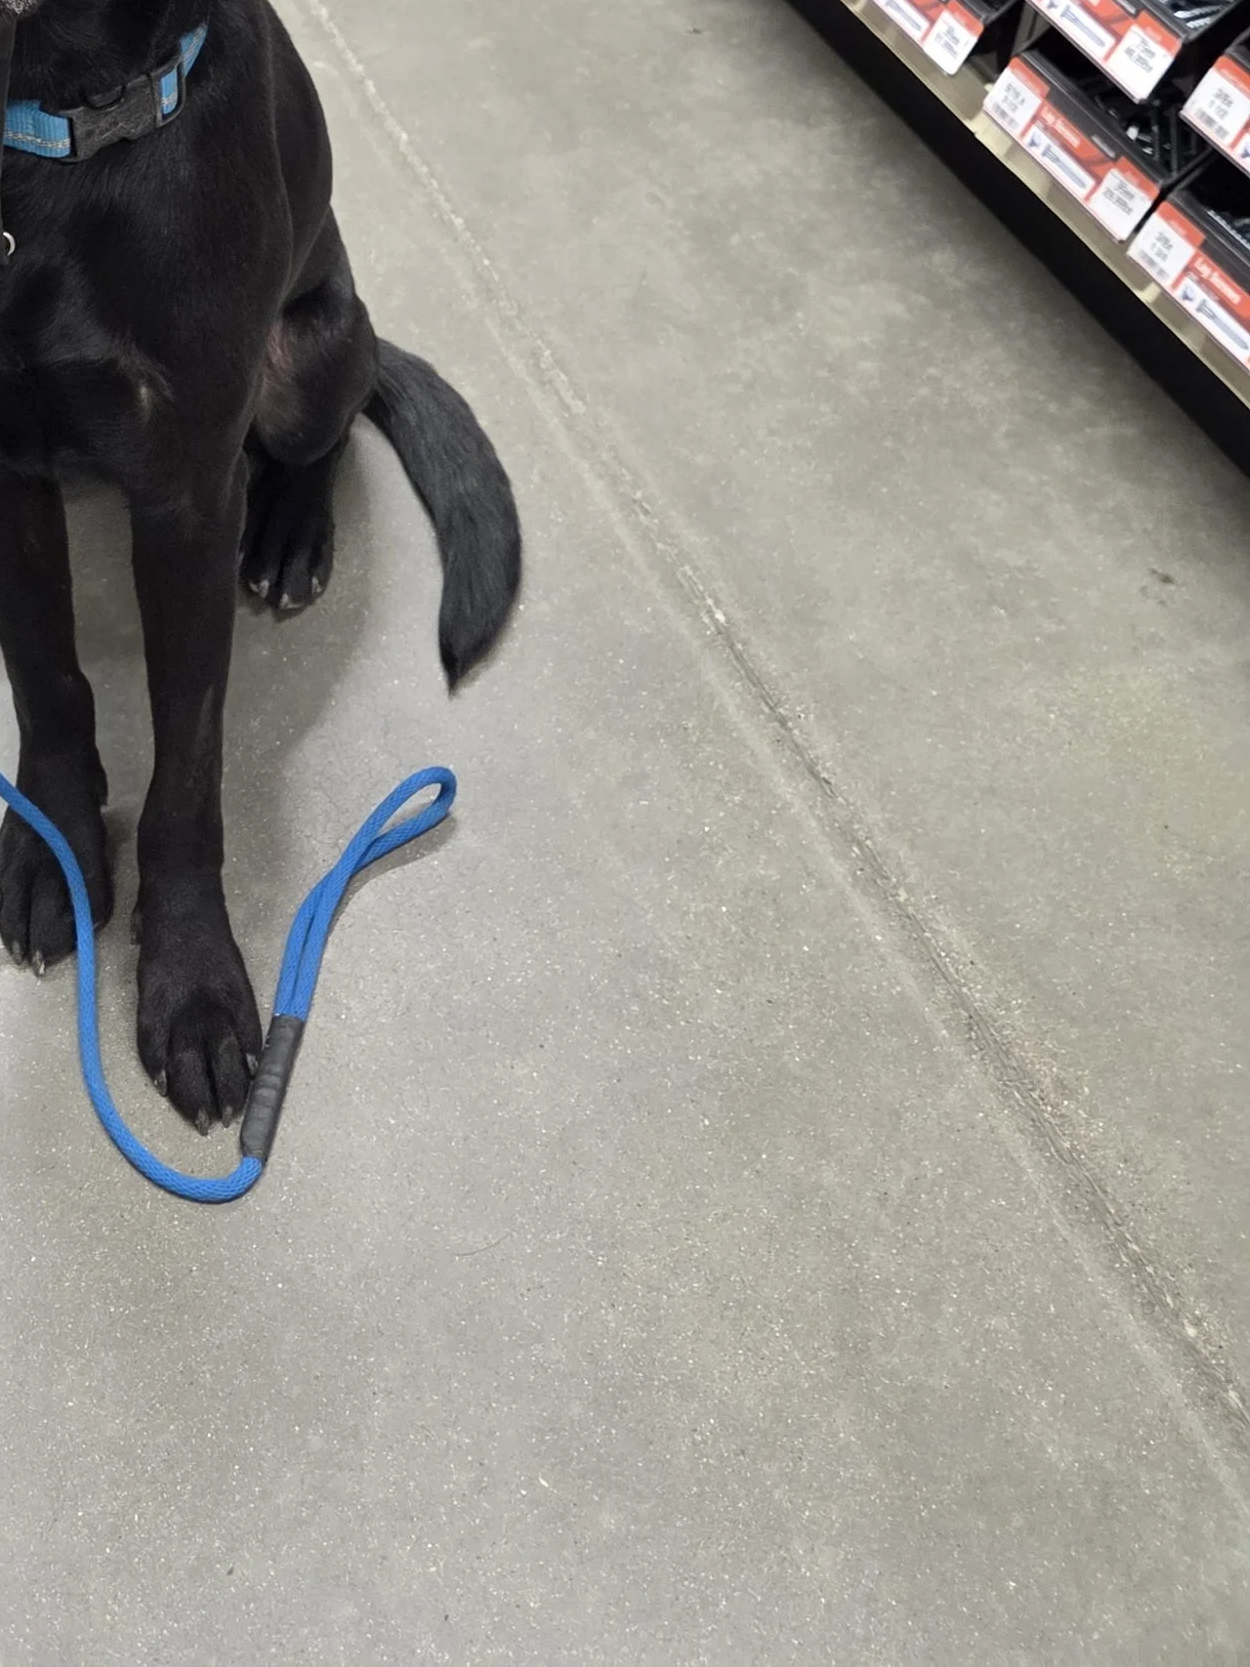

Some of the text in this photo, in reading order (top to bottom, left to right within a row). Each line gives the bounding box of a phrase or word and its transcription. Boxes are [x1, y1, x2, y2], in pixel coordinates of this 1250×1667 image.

[1040, 108, 1056, 125] Lag
[1054, 116, 1080, 148] Screws
[1194, 256, 1240, 306] Lag Screws
